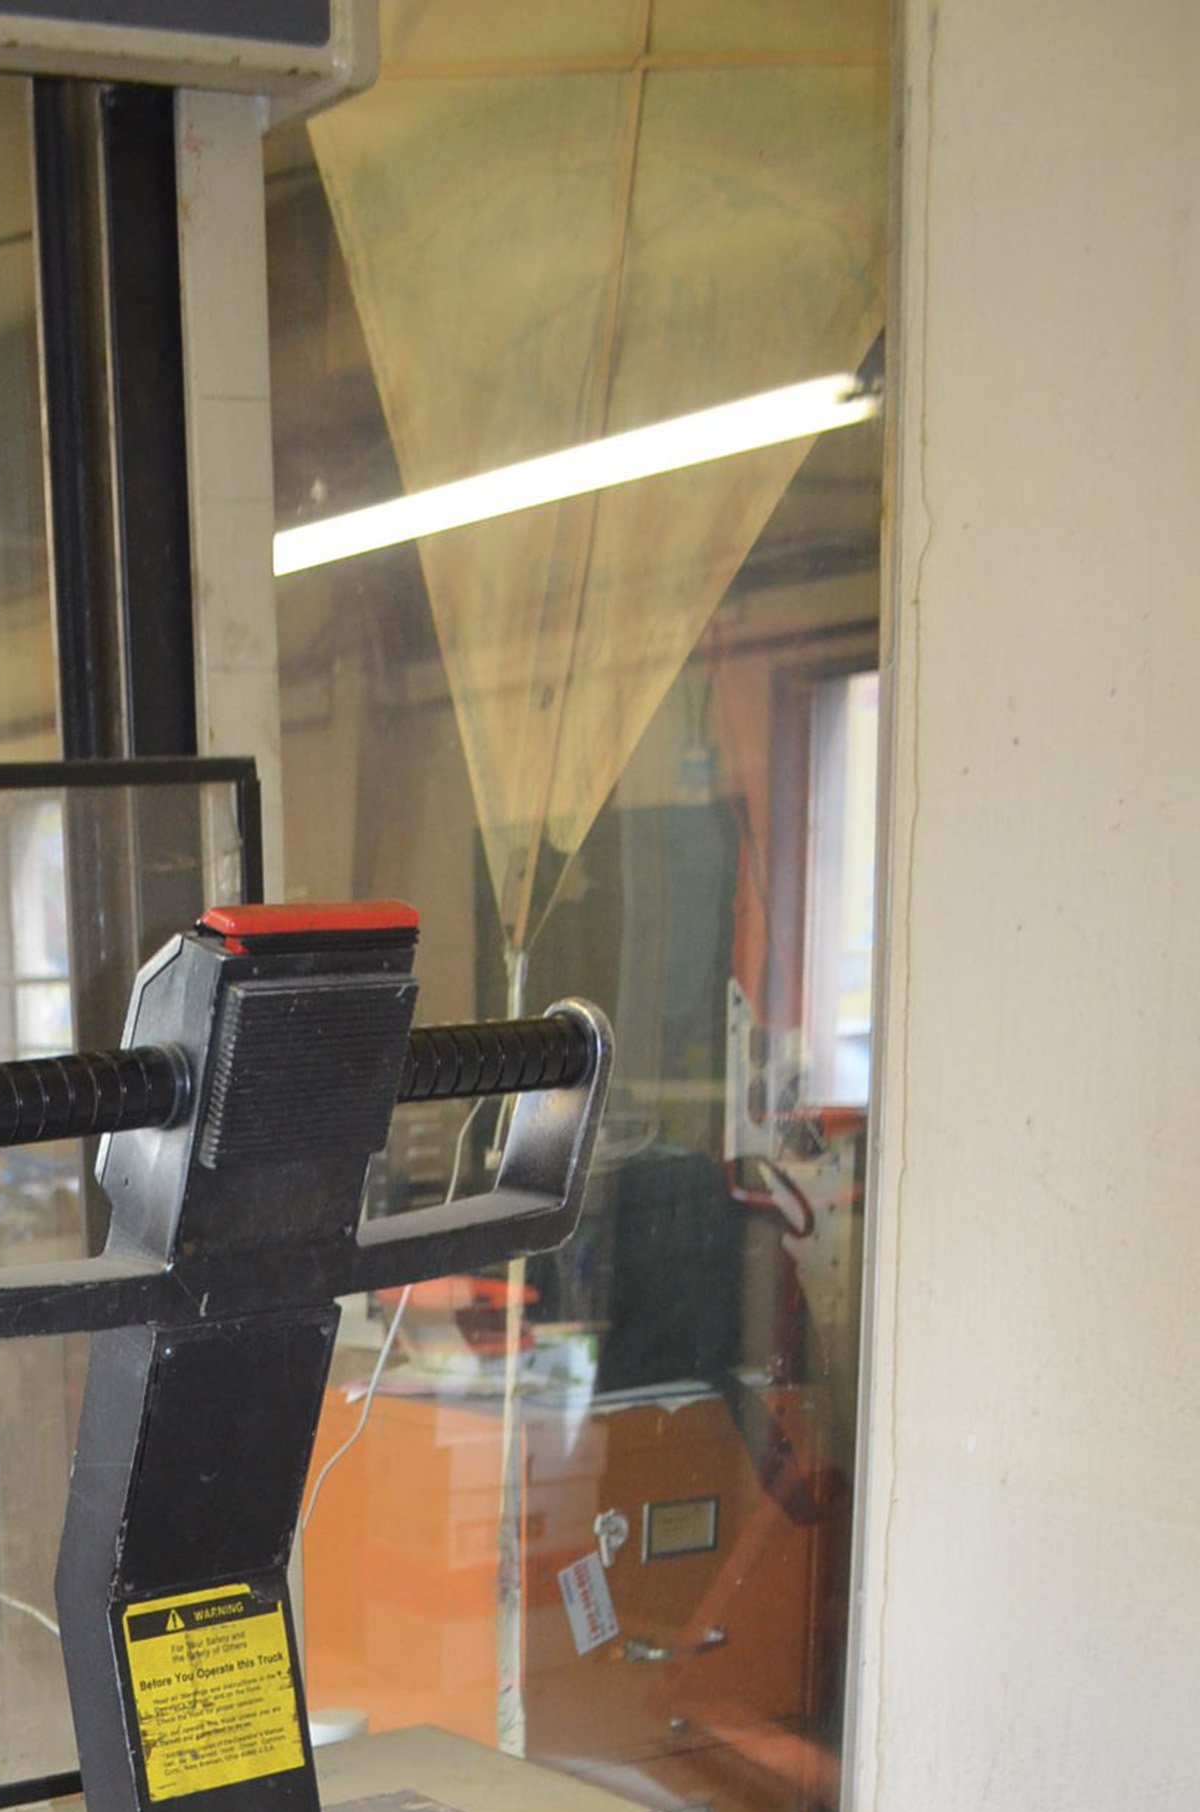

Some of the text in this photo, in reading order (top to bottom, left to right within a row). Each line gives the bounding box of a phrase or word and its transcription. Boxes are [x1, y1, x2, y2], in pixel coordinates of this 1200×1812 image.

[192, 1601, 245, 1622] WARNING
[139, 1649, 283, 1692] Before You Operate this Truck
